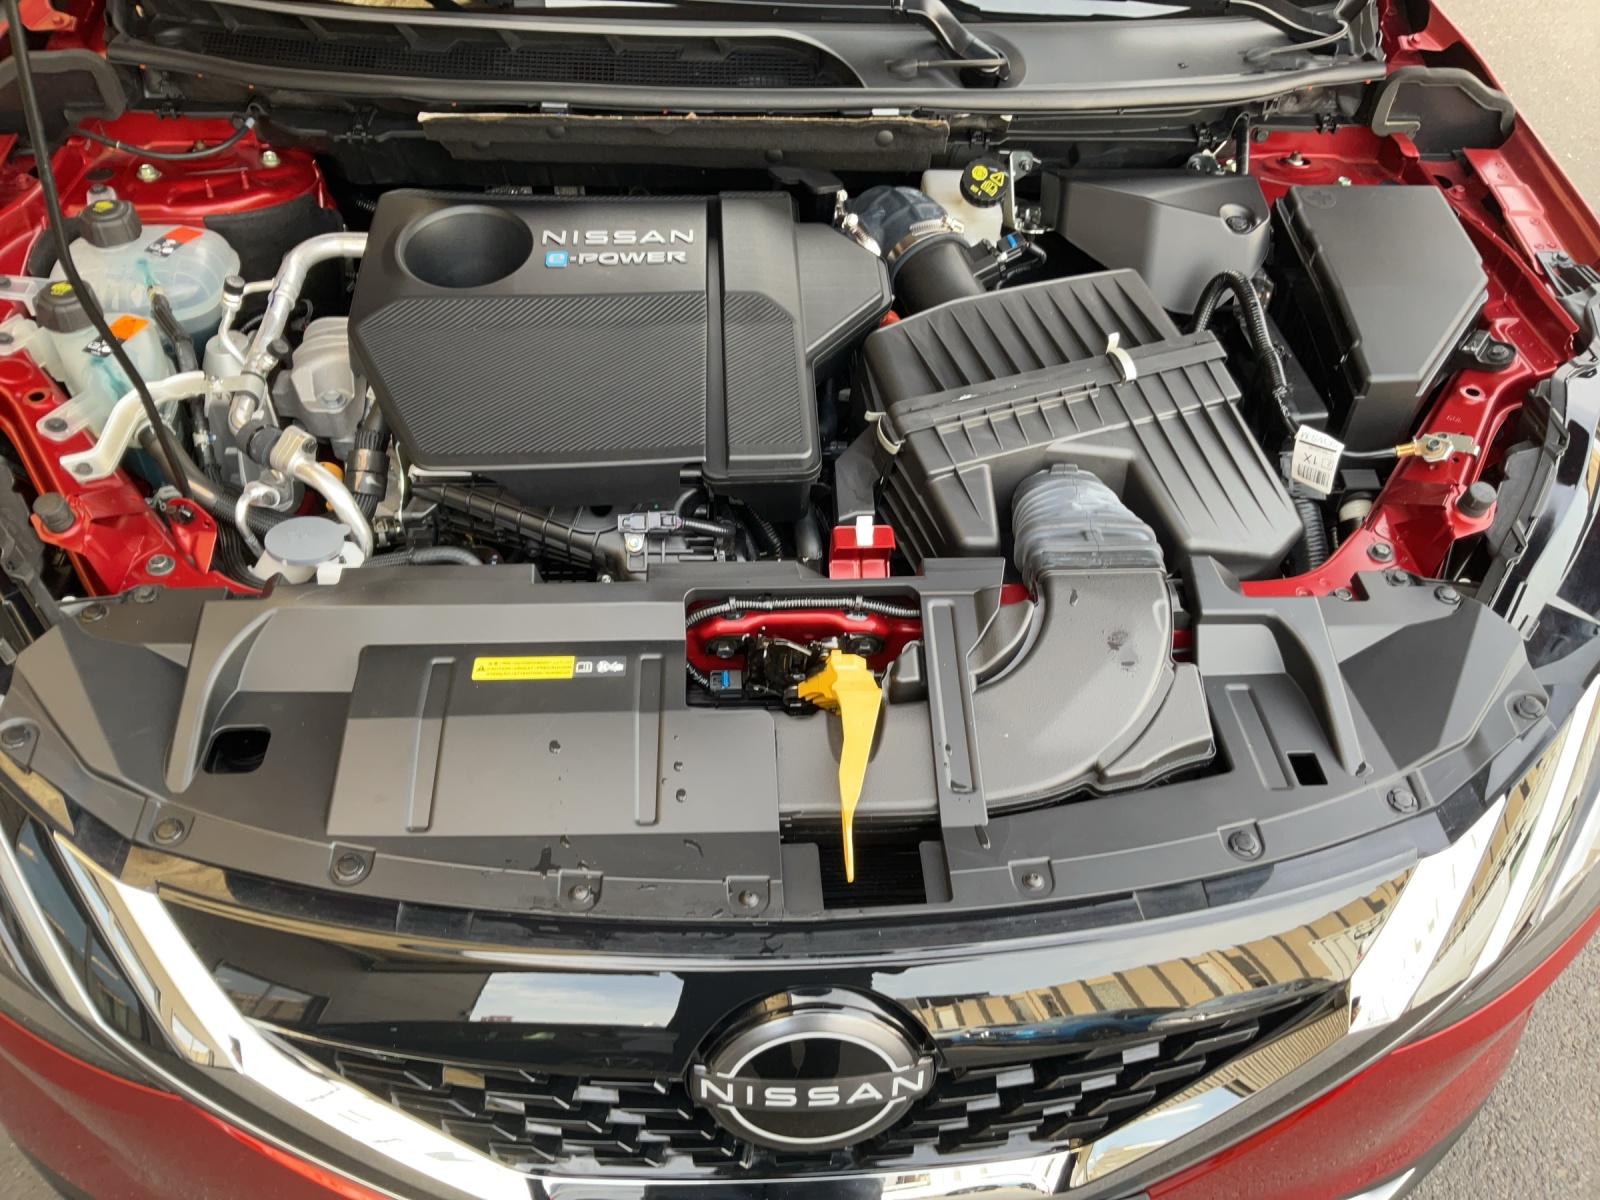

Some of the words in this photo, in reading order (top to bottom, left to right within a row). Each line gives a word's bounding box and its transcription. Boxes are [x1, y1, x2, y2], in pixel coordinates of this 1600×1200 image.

[541, 229, 694, 245] NISSAN
[545, 250, 687, 268] e-POWER
[701, 1070, 924, 1107] NISSAN
